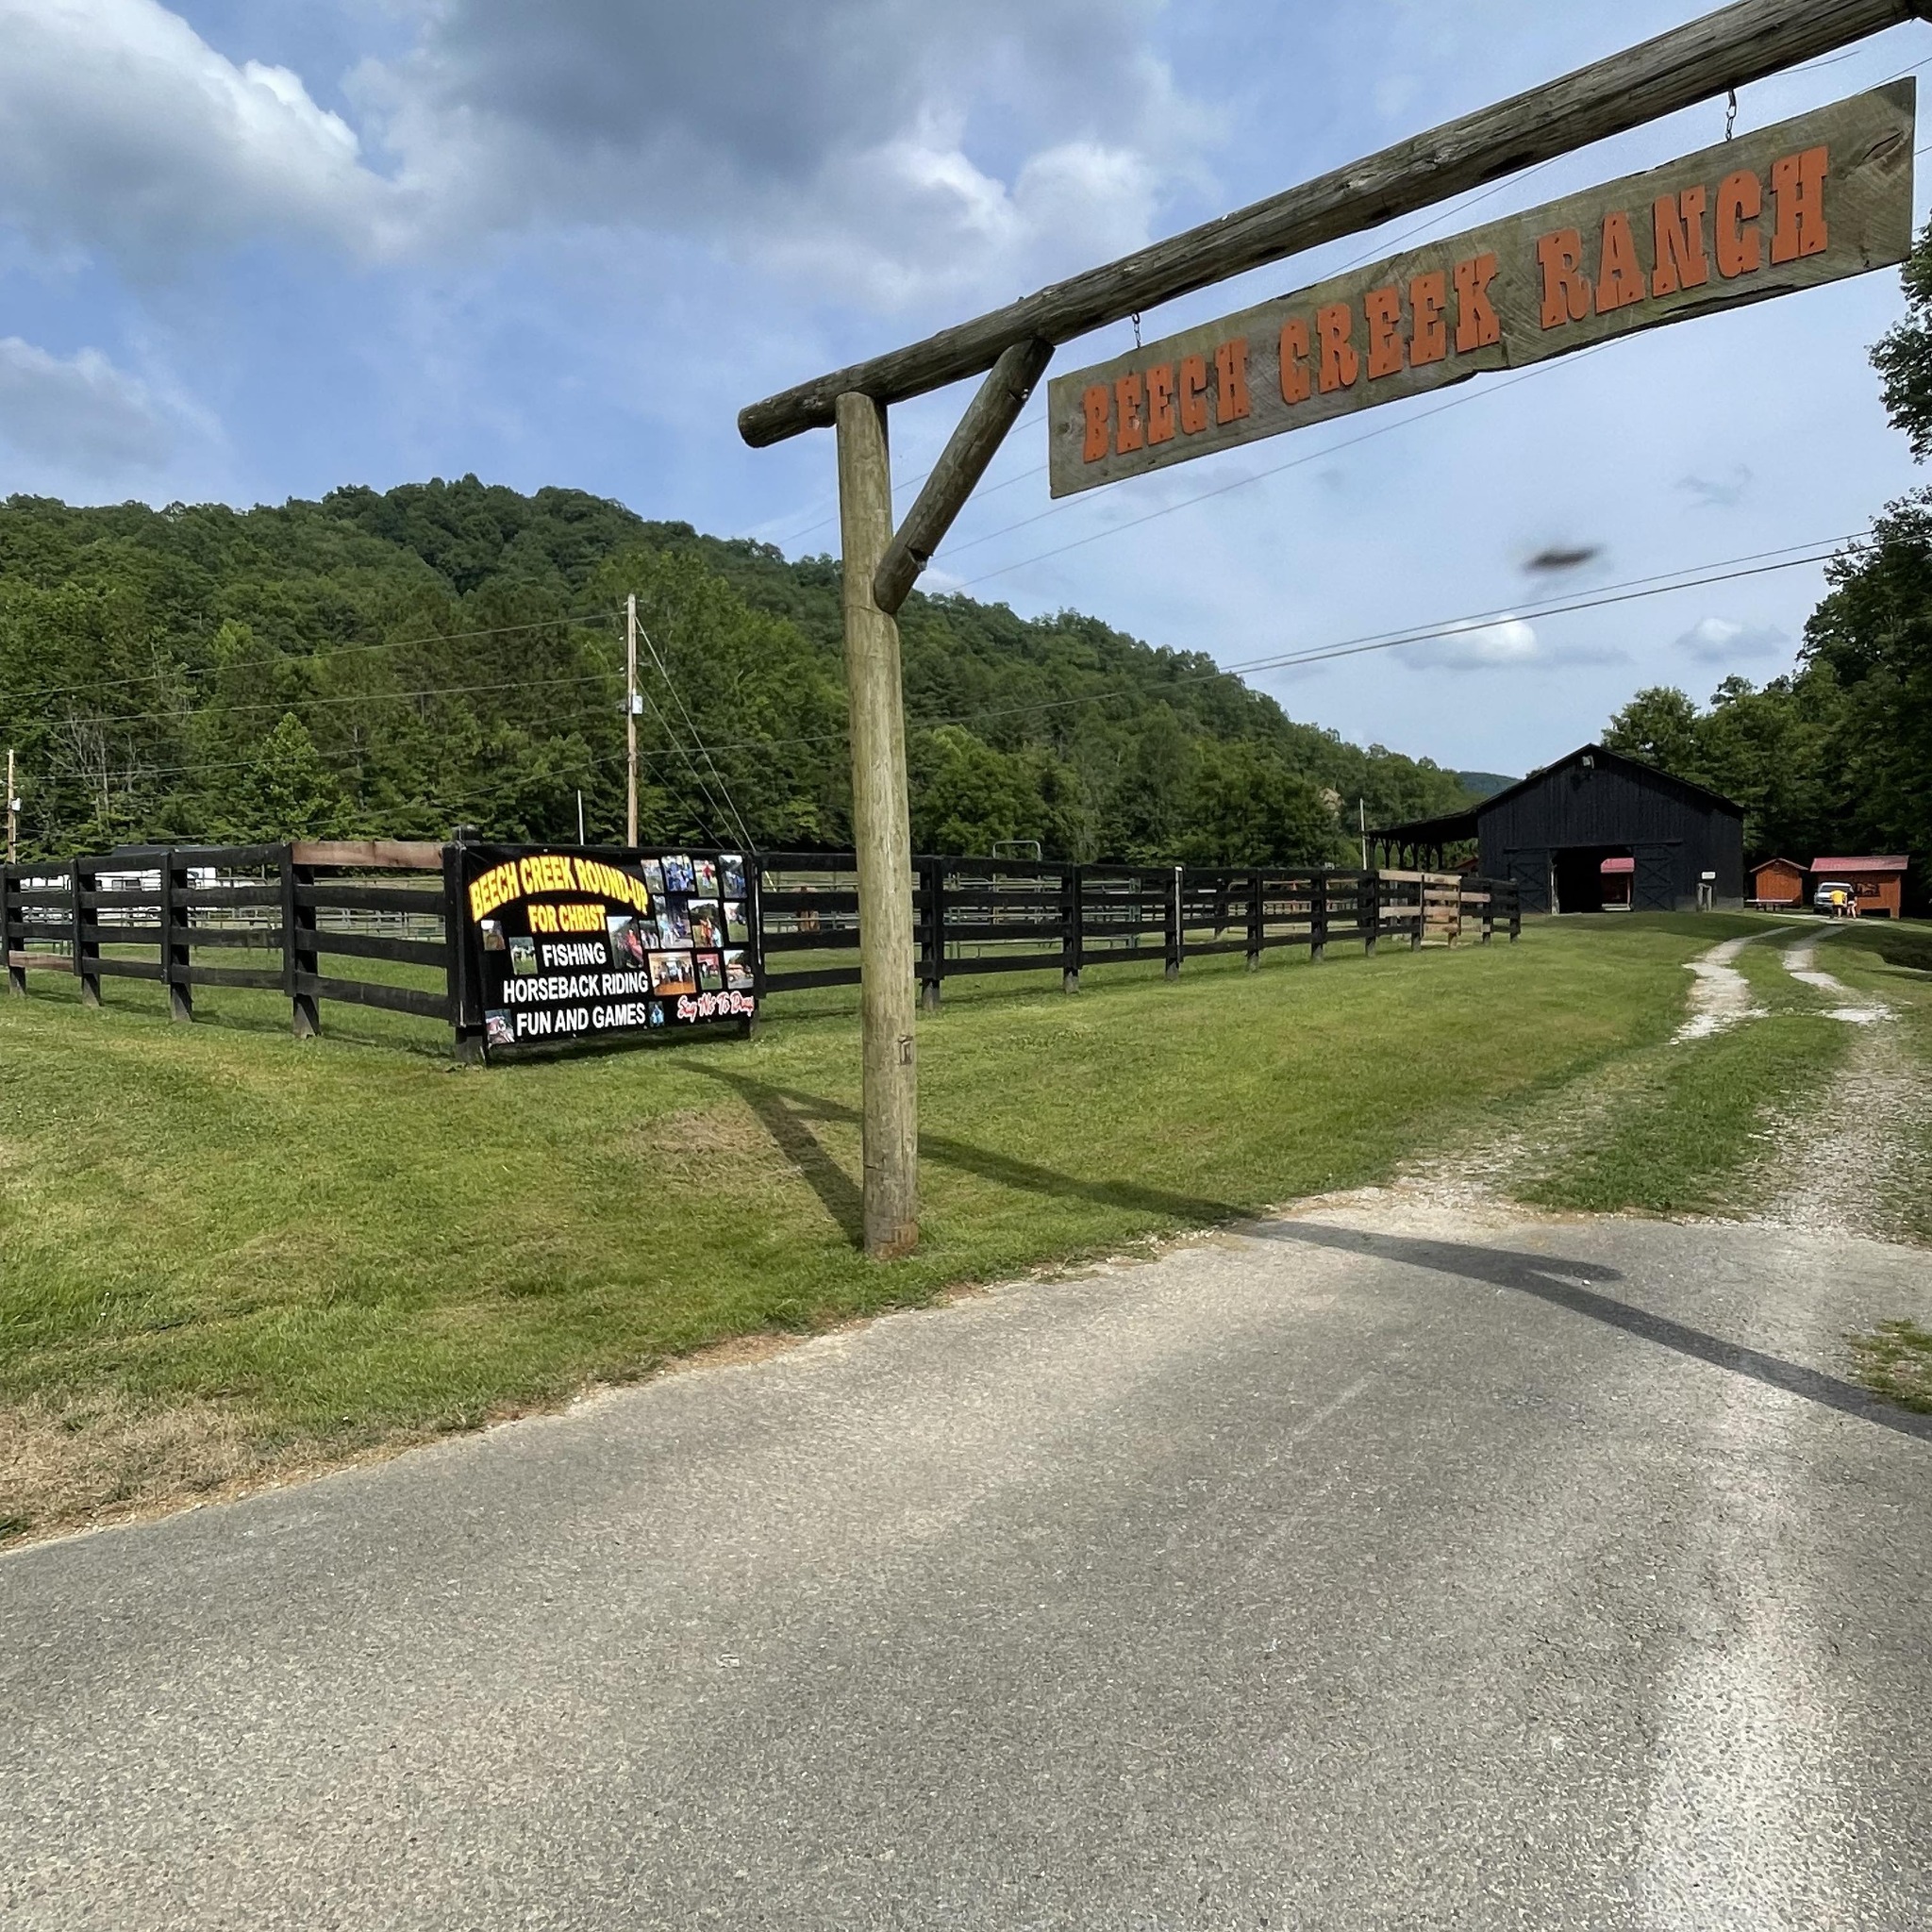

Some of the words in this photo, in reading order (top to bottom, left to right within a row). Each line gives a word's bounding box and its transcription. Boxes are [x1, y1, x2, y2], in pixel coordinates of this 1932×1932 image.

[1082, 337, 1250, 462] BEECH
[1278, 252, 1501, 404] CREEK
[1537, 144, 1830, 330] RANCH
[469, 860, 522, 924] BEECH
[520, 855, 578, 895] CREEK
[574, 857, 649, 916] ROUND-UP
[527, 904, 560, 934] FOR
[558, 904, 607, 933] CHRIST
[541, 941, 607, 968] FISHING
[503, 974, 599, 1004] HORSEBACK
[601, 971, 649, 997] RIDING
[516, 1010, 552, 1037] FUN
[554, 1008, 590, 1033] AND
[591, 1002, 646, 1029] GAMES
[677, 995, 698, 1024] Say
